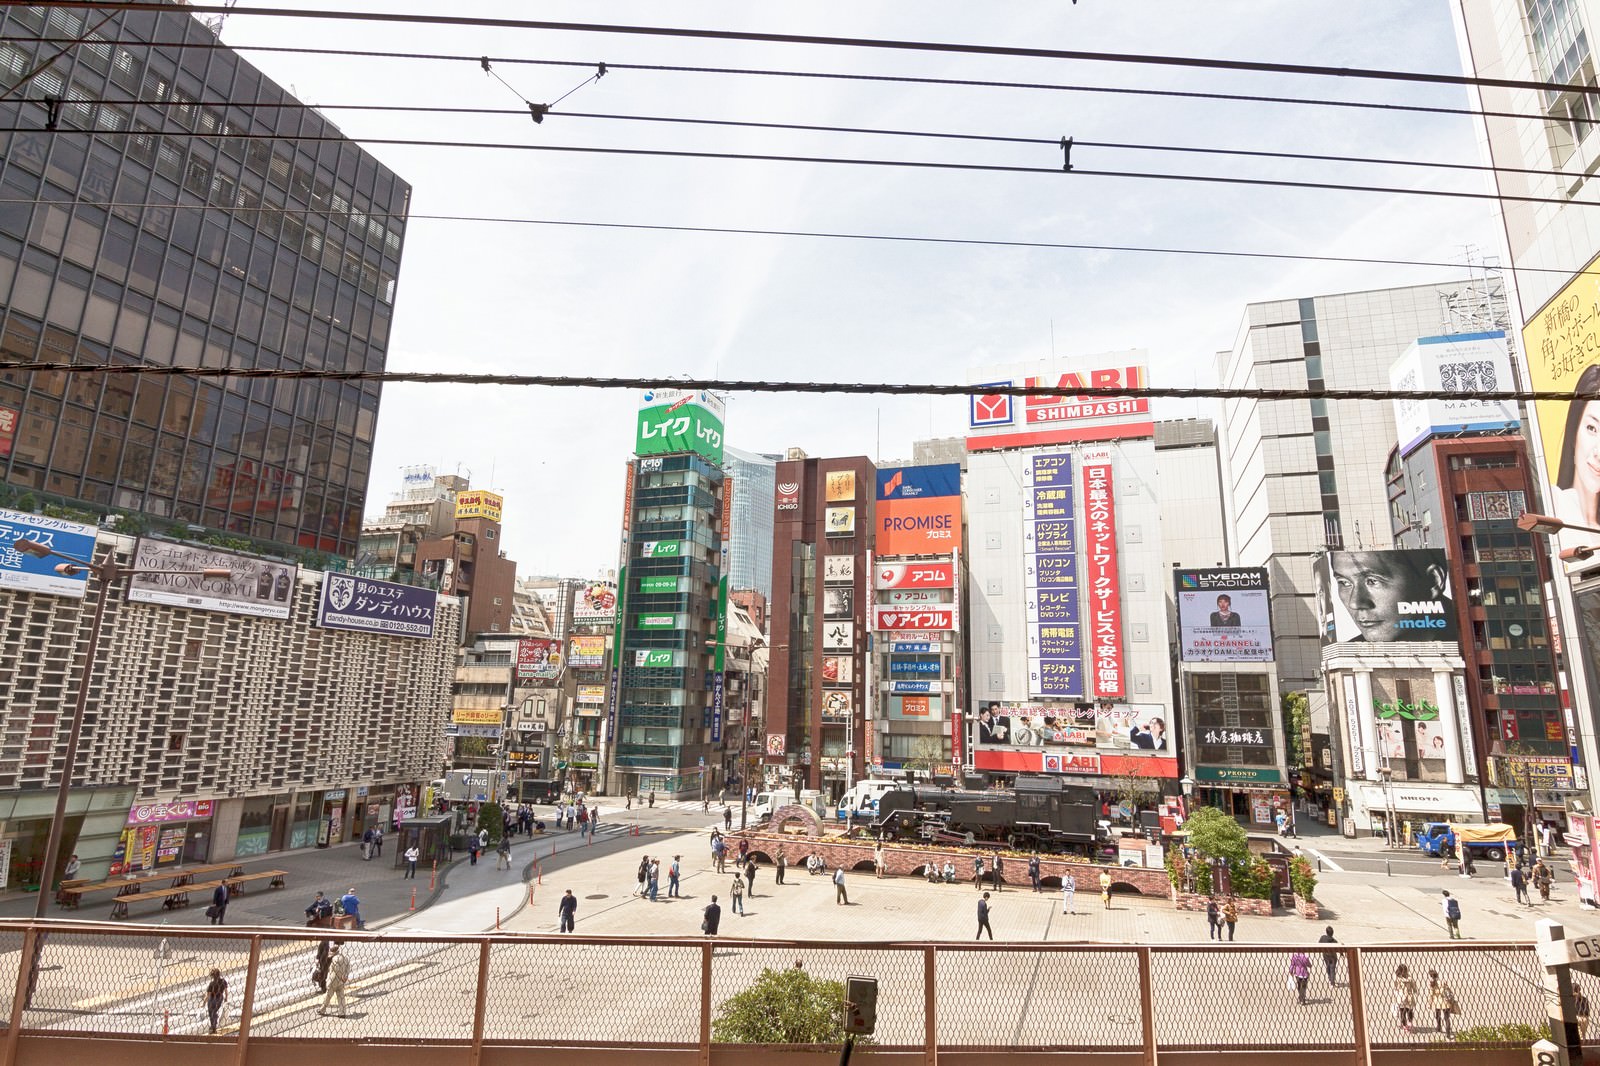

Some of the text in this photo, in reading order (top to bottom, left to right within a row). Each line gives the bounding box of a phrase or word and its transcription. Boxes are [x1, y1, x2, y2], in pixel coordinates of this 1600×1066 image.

[1544, 294, 1580, 335] 新橋の
[1025, 366, 1145, 406] LABI
[1037, 401, 1138, 421] SHIMBASHI
[642, 416, 690, 439] レイク
[696, 418, 721, 449] レイク
[641, 459, 661, 468] K-16
[1035, 457, 1066, 468] エアコン
[1036, 489, 1066, 500] 冷蔵庫
[884, 514, 952, 531] PROMISE
[1037, 522, 1068, 531] パソコン
[926, 530, 952, 539] プロミス
[1037, 530, 1068, 539] サプライ
[658, 543, 677, 553] レイク
[1038, 558, 1071, 568] パソコン
[912, 569, 945, 582] アコム
[1088, 467, 1119, 693] 日本最大のネットワークサービスで安心価格
[1199, 572, 1261, 580] LIVEDAM
[158, 574, 252, 597] MONGORYU
[356, 581, 405, 599] 男のエステ
[1040, 592, 1070, 603] テレビ
[218, 600, 288, 614] http://www.mongoryu.com
[354, 597, 432, 620] ダンディハウス
[1397, 600, 1445, 615] DMM
[327, 614, 429, 633] dandy-house.co.jp 0120-552-011
[898, 613, 948, 627] アイフル
[1393, 615, 1447, 629] .make
[1041, 627, 1075, 638] 携帯電話
[649, 654, 671, 663] レイク
[1042, 664, 1075, 674] デジカメ
[904, 704, 927, 712] プロミス
[1000, 706, 1141, 719] 最先端総合家電セレクトショップ
[1063, 731, 1086, 739] LABI
[1205, 731, 1264, 744] 椿屋珈琲店
[1062, 755, 1098, 768] LABI
[467, 778, 488, 786] CNG
[155, 803, 188, 816] 宝くじ
